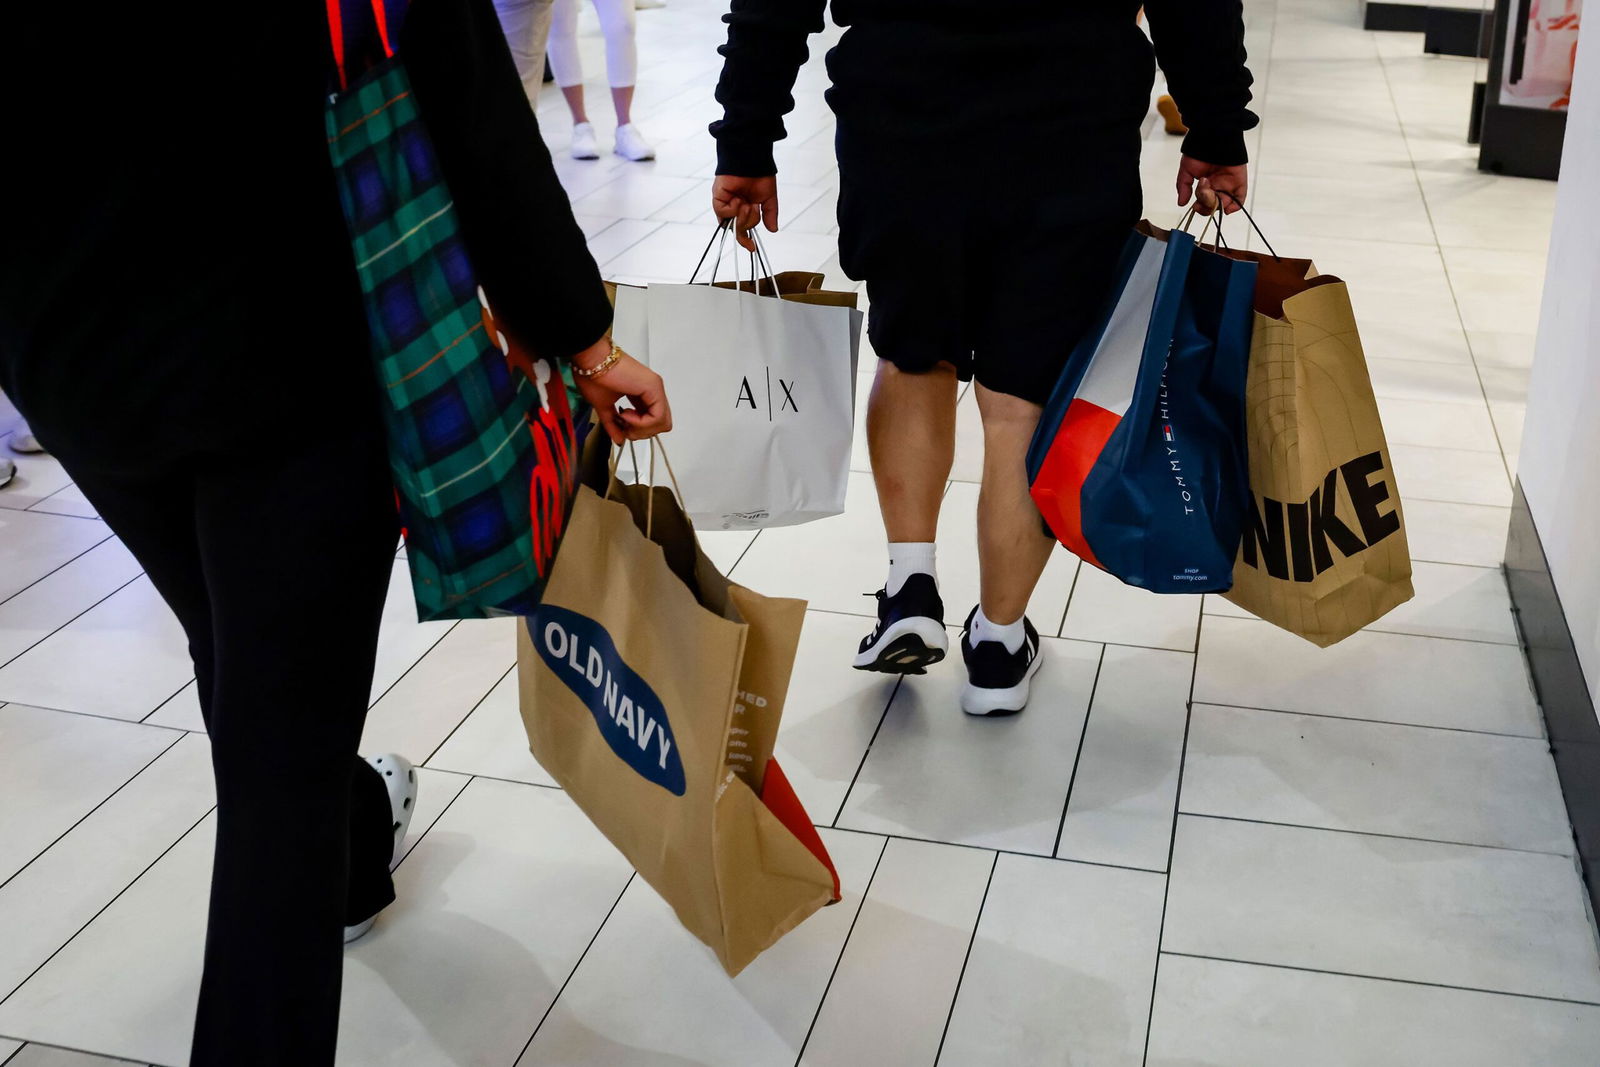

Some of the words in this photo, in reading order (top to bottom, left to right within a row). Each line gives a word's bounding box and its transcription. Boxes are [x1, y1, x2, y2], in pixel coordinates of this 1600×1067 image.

[1167, 447, 1194, 515] TOMMY
[1242, 450, 1401, 583] NIKE
[544, 621, 603, 688] OLD
[602, 670, 671, 770] NAVY
